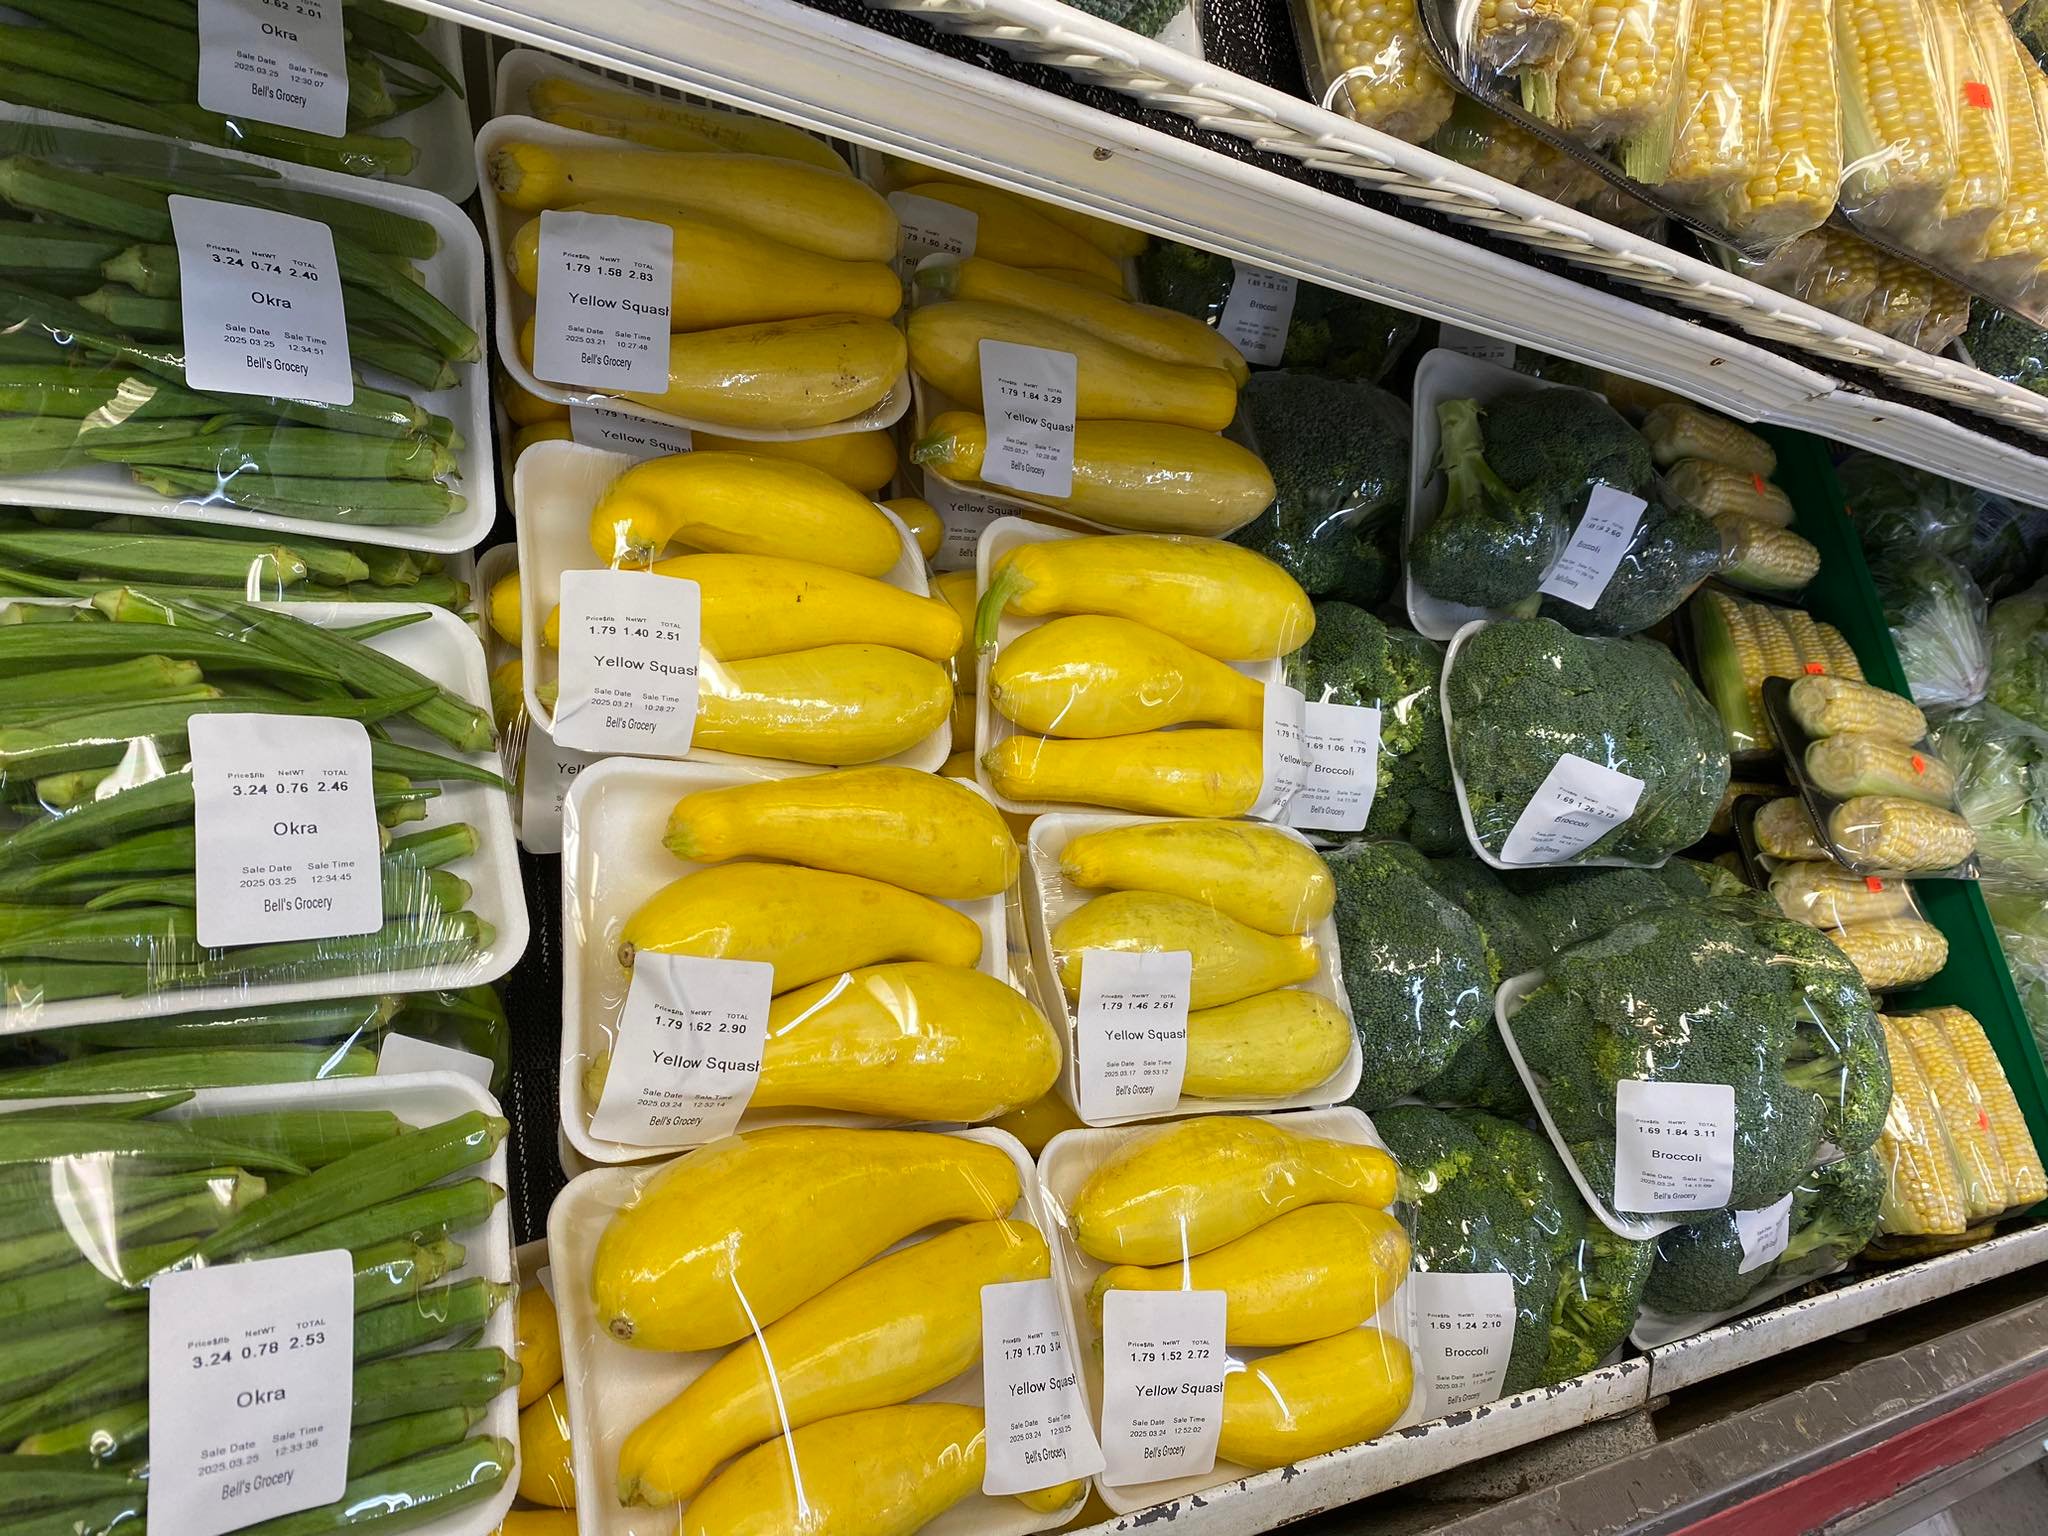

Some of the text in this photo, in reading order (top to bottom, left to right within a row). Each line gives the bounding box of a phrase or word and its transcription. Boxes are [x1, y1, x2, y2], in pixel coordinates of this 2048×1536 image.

[297, 6, 321, 19] 2.01
[261, 23, 298, 42] Okra
[252, 83, 306, 108] Bell's Grocery
[922, 237, 939, 247] 1.50
[212, 254, 318, 281] 3.24 0.74 2.40
[293, 259, 317, 269] TOTAL
[634, 262, 653, 270] TOTAL
[565, 263, 653, 282] 1.79 1.58 2.83
[251, 291, 292, 309] Okra
[569, 292, 617, 308] Yellow
[225, 323, 327, 345] Sale Date Sale Time
[224, 335, 324, 355] 2025.03.25 12:34:51
[246, 355, 309, 376] Bell's Grocery
[581, 353, 632, 370] Bell's Grocery
[1001, 387, 1062, 404] 1.79 1.84 3.29
[595, 409, 617, 417] 1.79
[1004, 410, 1038, 425] Yellow
[601, 429, 645, 444] Yellow
[1026, 463, 1045, 477] Grocery
[950, 503, 984, 513] Yellow
[589, 626, 680, 641] 1.79 1.40 2.51
[594, 656, 645, 670] Yellow
[592, 698, 633, 708] 2025.03.21
[606, 716, 657, 734] Bell's Grocery
[1277, 730, 1289, 738] 1.79
[1306, 742, 1323, 750] 1.69
[1279, 753, 1300, 765] Yellow
[557, 762, 586, 774] Yell
[1315, 765, 1354, 776] Broccoli
[233, 782, 348, 796] 3.24 0.76 2.46
[1556, 794, 1574, 805] 1.69
[1578, 802, 1594, 813] 1.26
[274, 822, 318, 836] Okra
[1554, 816, 1589, 828] Broccoli
[242, 866, 266, 874] Sale
[308, 862, 329, 870] Sale
[332, 860, 355, 868] Time
[240, 874, 351, 888] 2025.03.25 12:34:45
[264, 897, 332, 912] Bell's Grocery
[1102, 1002, 1123, 1010] 1.79
[1154, 1001, 1174, 1009] 2.61
[655, 1016, 747, 1034] 1.79 1.62 2.90
[1105, 1030, 1144, 1040] Yellow
[652, 1050, 702, 1069] Yellow
[643, 1088, 662, 1098] Sale
[1115, 1085, 1154, 1096] Bell's Grocery
[650, 1116, 703, 1126] Bell's Grocery
[1639, 1126, 1716, 1137] 1.69 1.84 3.11
[1652, 1150, 1702, 1162] Broccoli
[245, 1319, 326, 1338] NetWT TOTAL
[1483, 1321, 1501, 1329] 2.10
[192, 1332, 325, 1369] 3.24 0.78 2.53
[1005, 1350, 1023, 1360] 1.79
[1027, 1345, 1047, 1357] 1.70
[1131, 1350, 1209, 1362] 1.79 1.52 2.72
[1445, 1347, 1489, 1357] Broccoli
[1008, 1380, 1046, 1397] Yellow
[1135, 1385, 1178, 1397] Yellow
[237, 1388, 286, 1408] Okra
[201, 1425, 324, 1459] Sale Date Sale Time
[1025, 1447, 1067, 1464] Bell's Grocery
[1144, 1445, 1185, 1459] Bell's Grocery
[198, 1455, 260, 1476] 2025.03.25
[222, 1470, 295, 1500] Bell's Grocery
